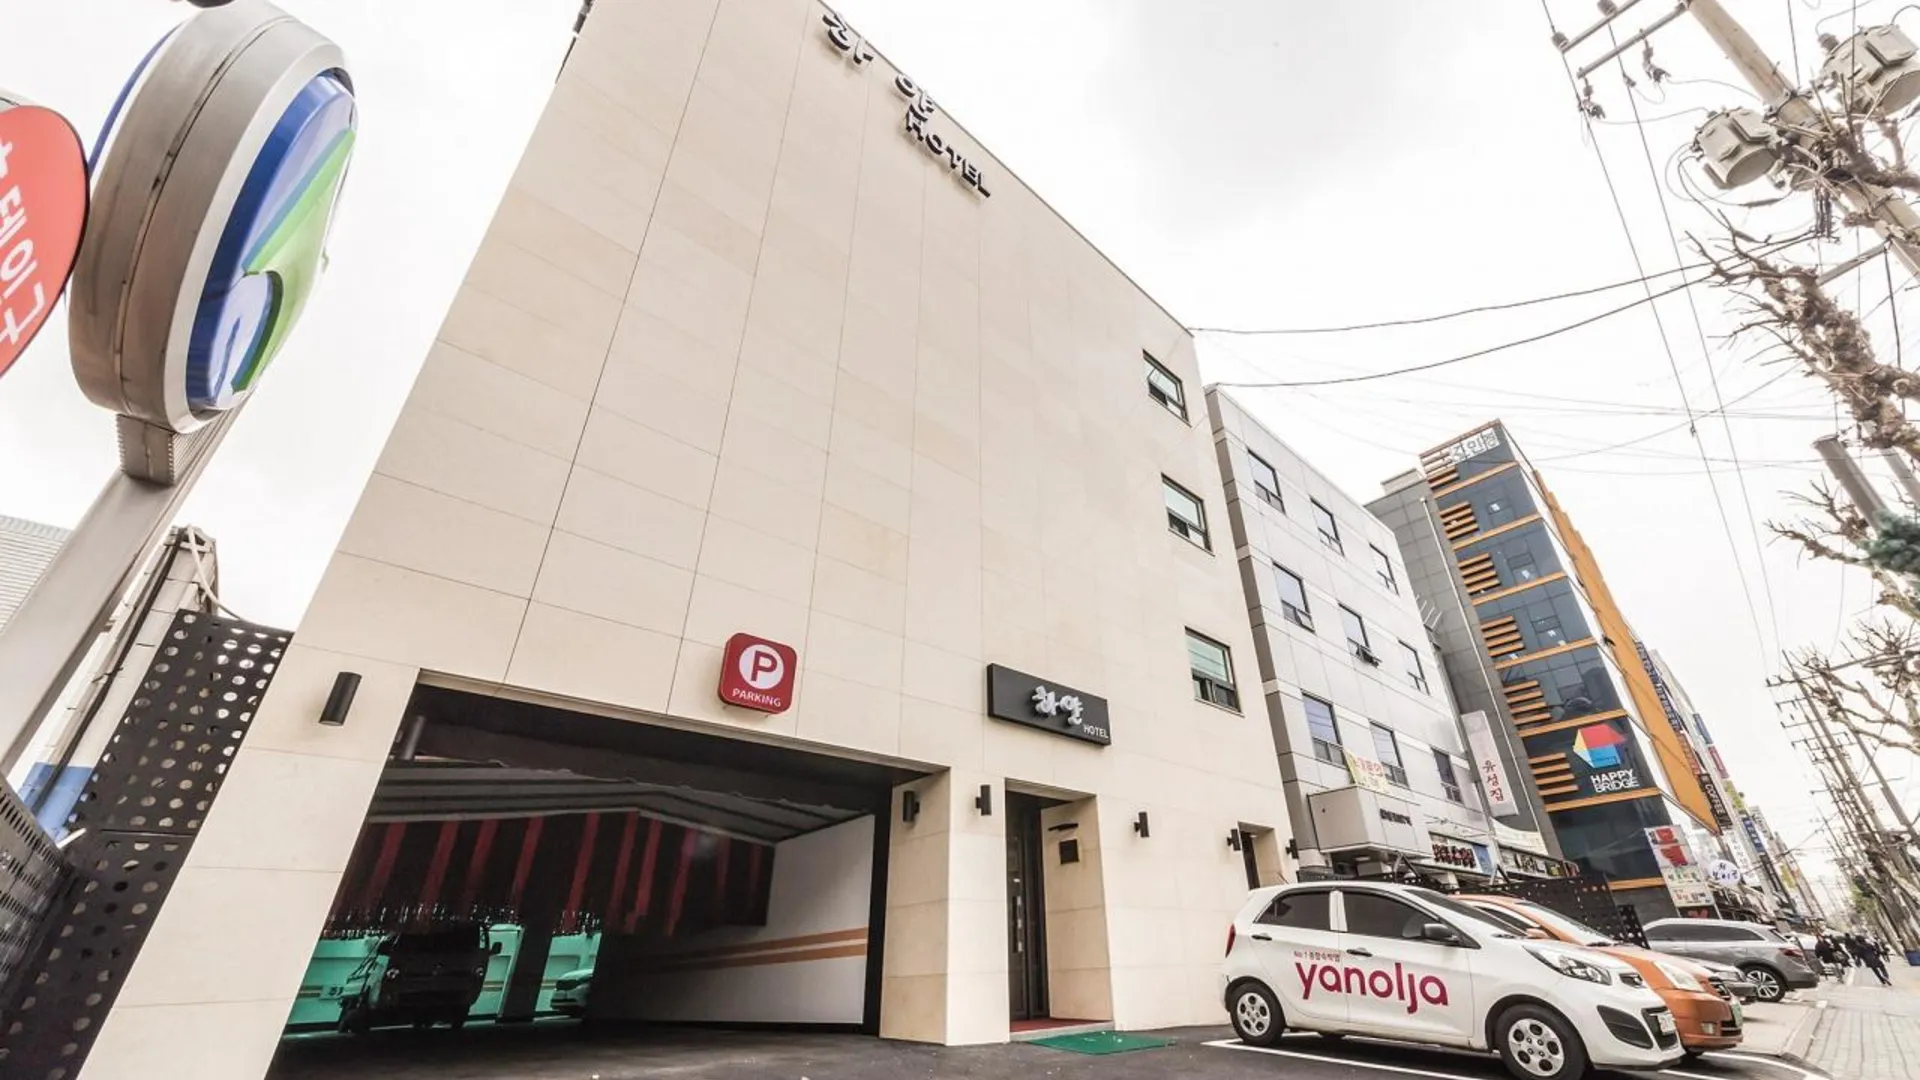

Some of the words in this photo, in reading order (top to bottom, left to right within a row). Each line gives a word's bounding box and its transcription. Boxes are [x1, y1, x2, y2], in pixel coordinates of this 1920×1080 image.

[905, 109, 991, 198] HOTEL
[751, 650, 778, 682] P
[732, 688, 781, 707] PARKING
[1083, 724, 1109, 739] HOTEL
[1590, 769, 1634, 783] HAPPY
[1594, 777, 1640, 793] BRIDGE
[1704, 783, 1726, 815] COFFEE
[1295, 962, 1448, 1014] yanolja
